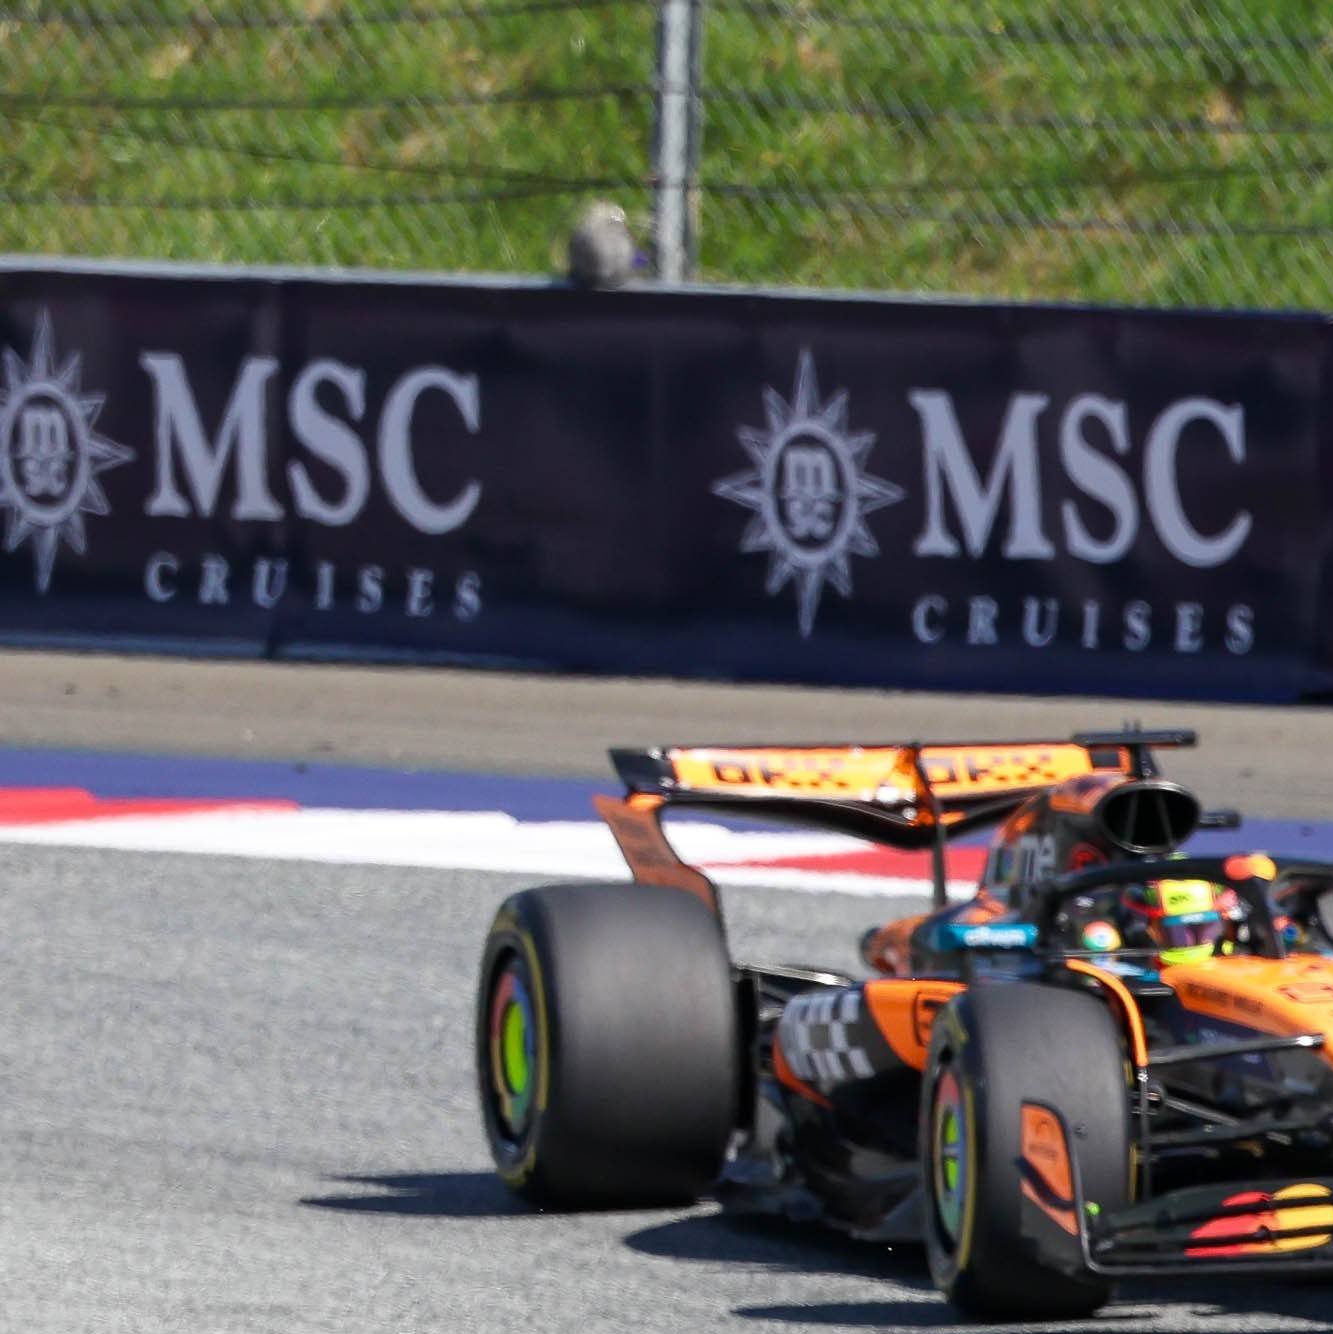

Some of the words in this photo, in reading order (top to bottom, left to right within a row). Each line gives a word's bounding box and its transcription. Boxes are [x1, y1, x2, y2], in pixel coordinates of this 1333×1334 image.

[139, 351, 483, 535] MSC
[908, 387, 1253, 567] MSC
[145, 553, 482, 619] CRUISES
[912, 595, 1255, 654] CRUISES
